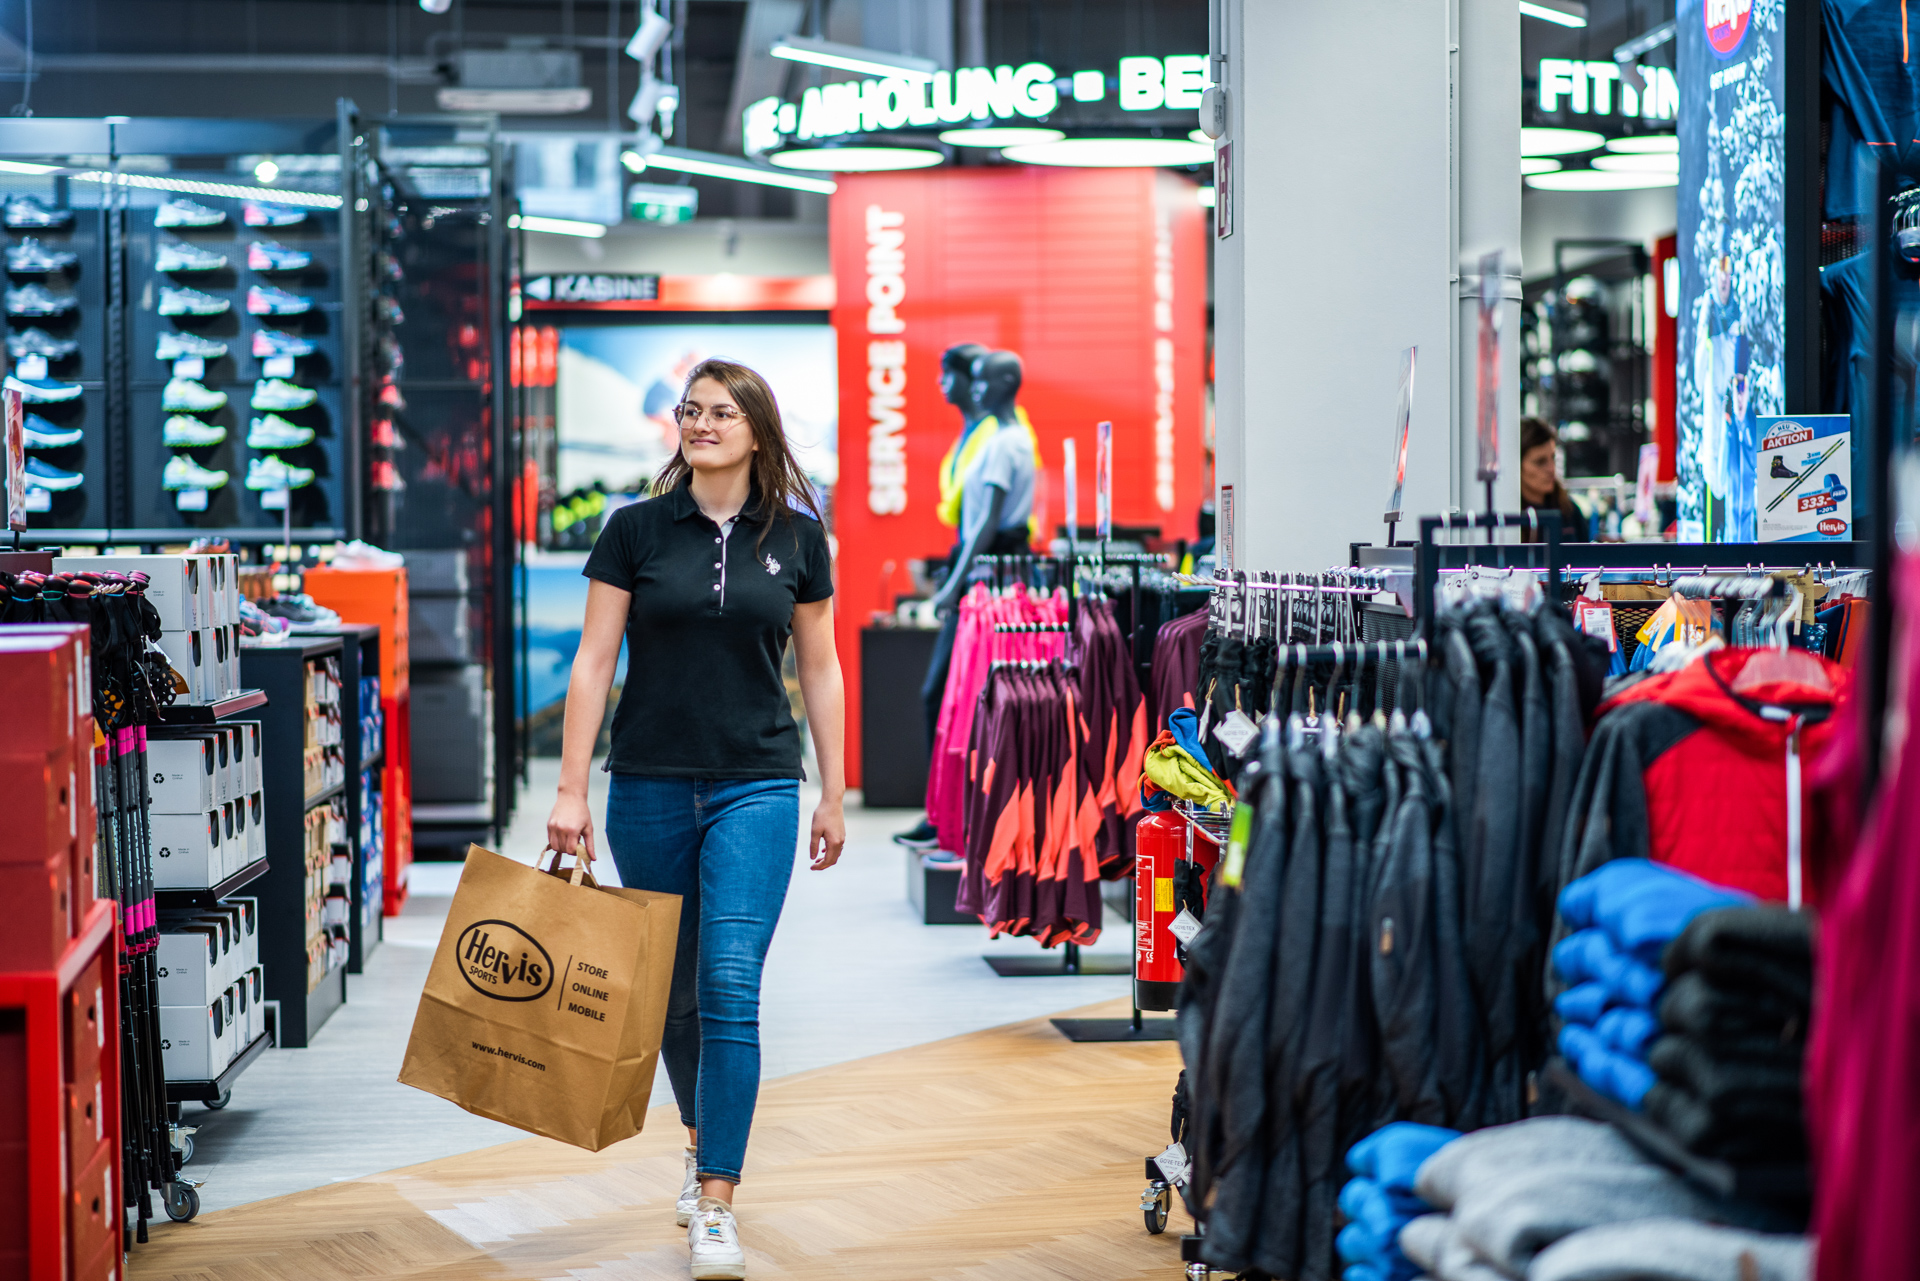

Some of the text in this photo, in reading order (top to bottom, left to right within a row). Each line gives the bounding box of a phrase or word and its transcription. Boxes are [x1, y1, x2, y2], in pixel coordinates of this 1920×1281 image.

[797, 62, 1057, 140] ABHOLUNG
[555, 275, 656, 301] KABINE
[865, 204, 908, 516] SERVICE POINT
[1767, 432, 1808, 449] AKTION
[1819, 521, 1846, 533] Hervis
[464, 929, 543, 987] Hervis
[469, 965, 498, 985] SPORTS
[577, 962, 609, 980] STORE
[572, 982, 609, 1001] ONLINE
[567, 1002, 606, 1022] MOBILE
[471, 1041, 546, 1072] www.hervis.com
